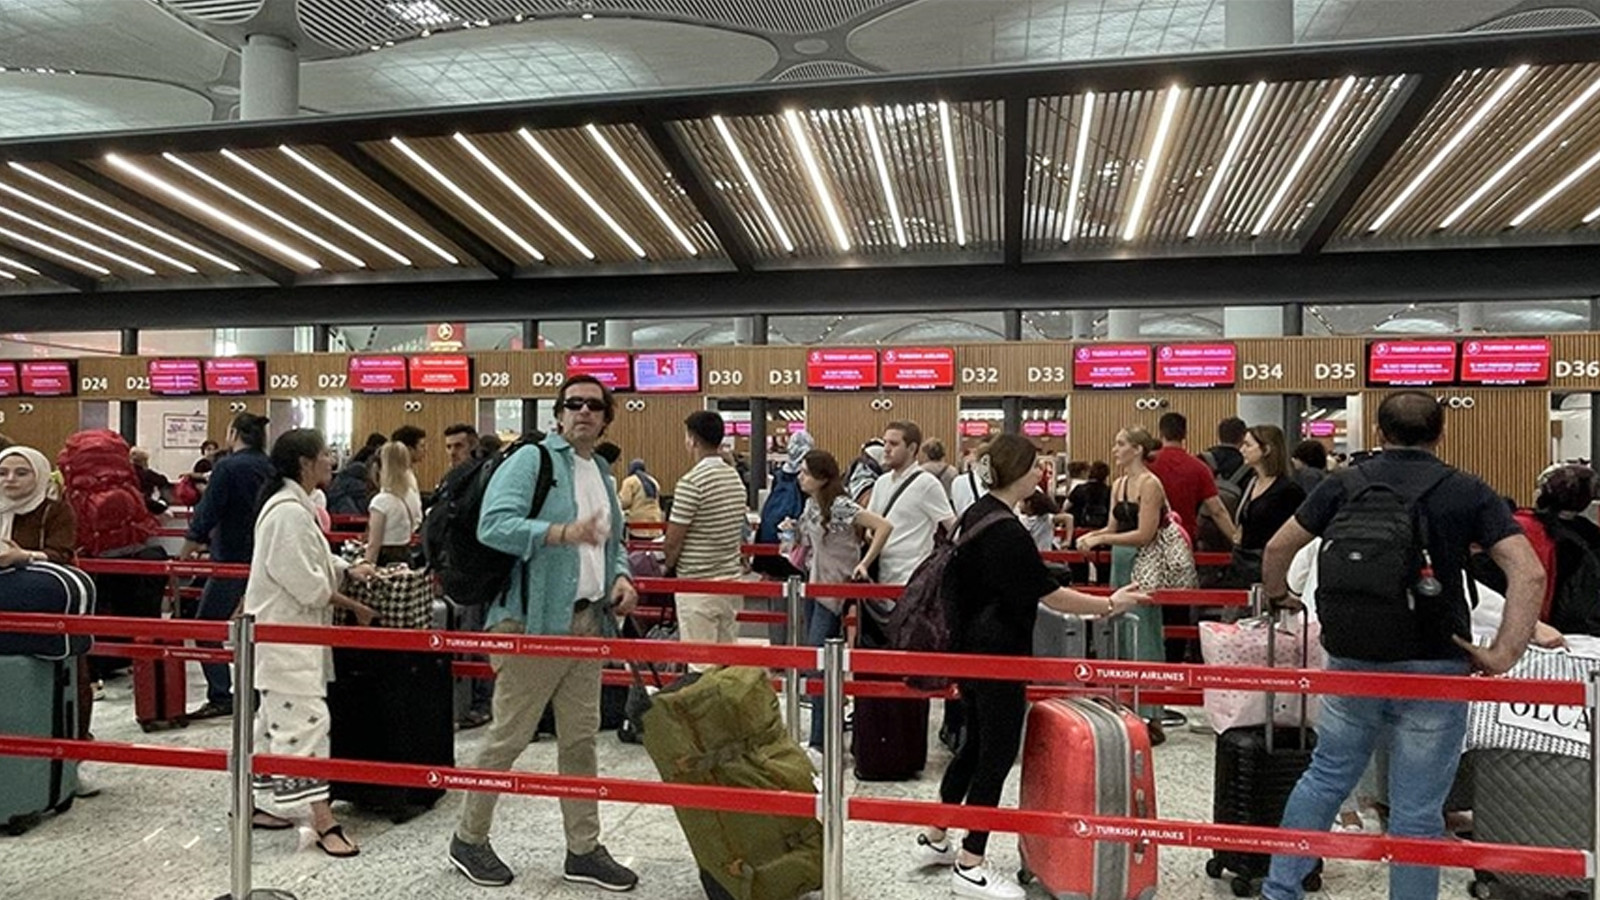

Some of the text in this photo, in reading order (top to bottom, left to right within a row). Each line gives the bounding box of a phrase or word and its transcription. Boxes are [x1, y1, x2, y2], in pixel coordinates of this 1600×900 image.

[586, 322, 599, 343] F
[962, 368, 998, 383] D32
[1028, 367, 1065, 382] D33
[1242, 363, 1284, 380] D34
[1314, 363, 1356, 379] D35
[1555, 360, 1600, 377] D36
[81, 377, 109, 391] D24
[270, 375, 299, 389] D26
[318, 374, 348, 388] D27
[480, 372, 510, 387] D28
[532, 372, 564, 386] D29
[708, 370, 743, 385] D30
[769, 370, 801, 384] D31
[445, 638, 479, 647] TURKISH
[480, 639, 515, 650] AIRLINES
[1096, 668, 1139, 678] TURKISH
[1140, 671, 1185, 682] AIRLINES
[443, 775, 477, 785] TURKISH
[478, 778, 513, 789] AIRLINES
[1095, 825, 1138, 837] TURKISH
[1140, 829, 1185, 840] AIRLINES
